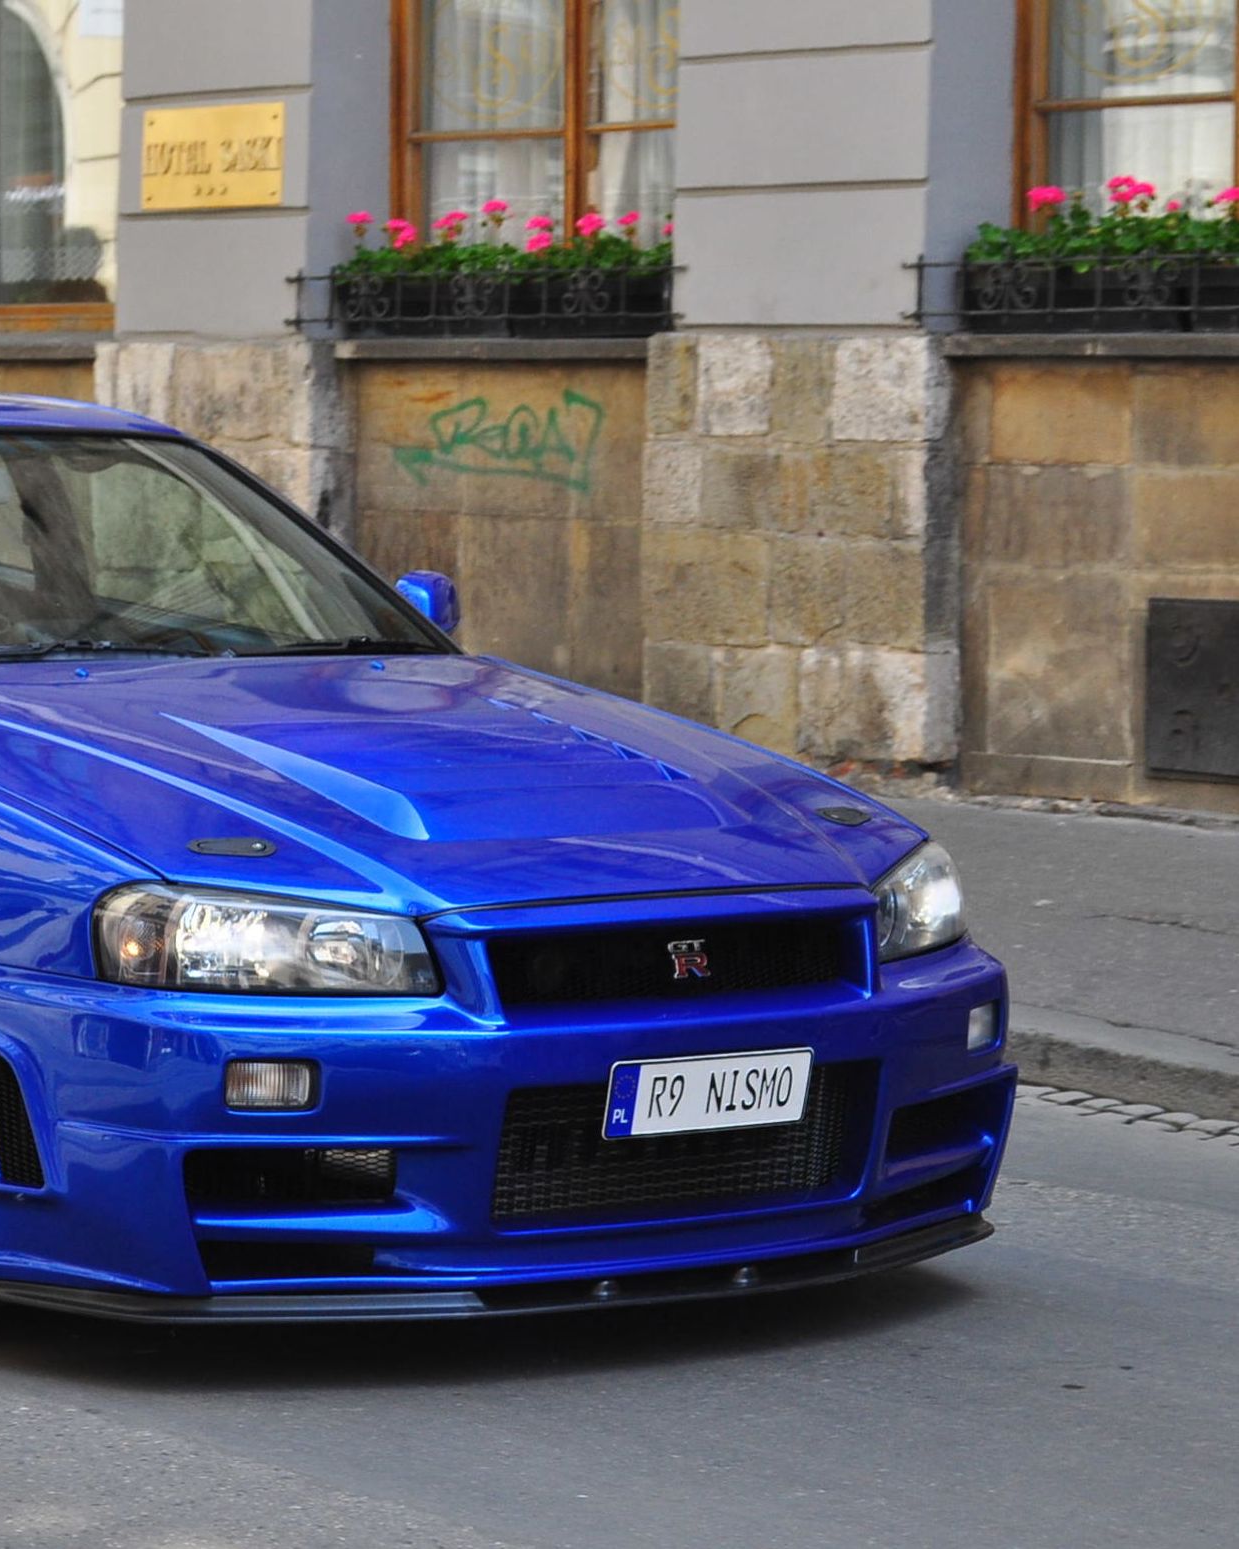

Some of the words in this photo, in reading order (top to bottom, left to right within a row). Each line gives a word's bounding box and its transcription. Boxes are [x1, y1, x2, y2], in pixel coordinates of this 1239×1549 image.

[142, 139, 213, 177] HOTEL
[672, 952, 711, 979] R
[647, 1074, 685, 1118] R9
[705, 1065, 794, 1114] NISMO
[611, 1108, 629, 1125] PL
